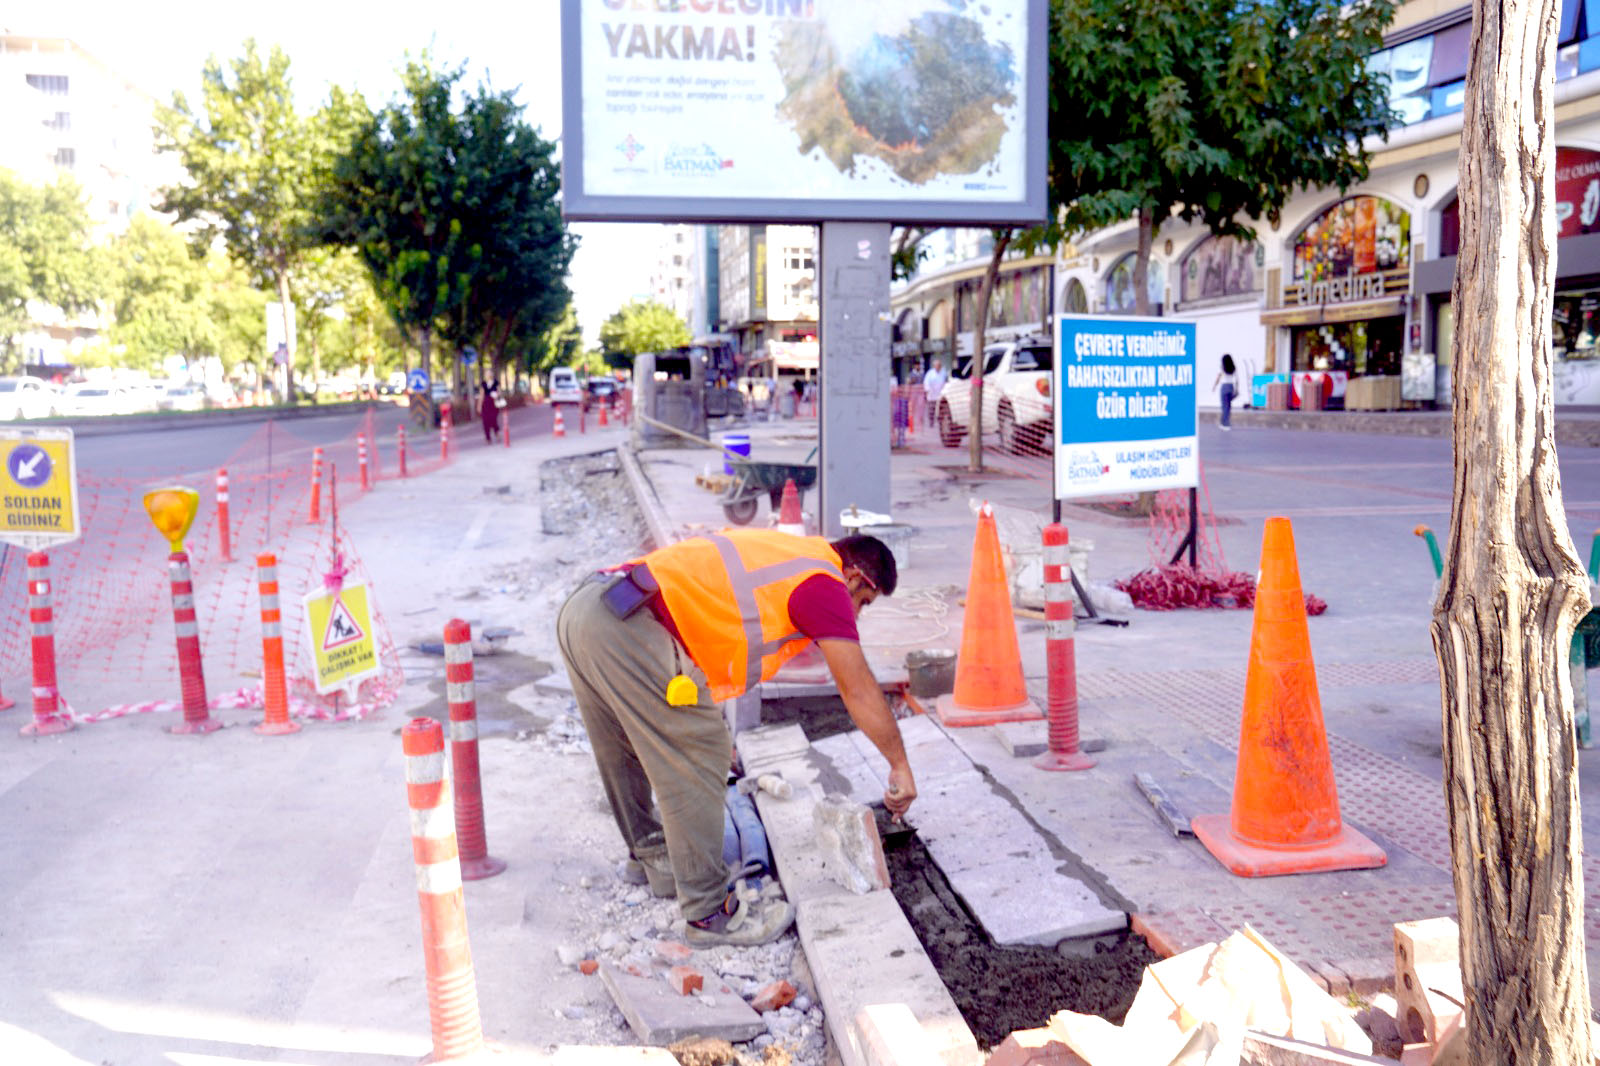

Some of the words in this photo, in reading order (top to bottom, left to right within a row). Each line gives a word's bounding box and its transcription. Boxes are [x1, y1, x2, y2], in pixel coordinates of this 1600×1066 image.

[602, 22, 755, 62] YAKMA!
[664, 156, 723, 171] BATMAN
[1297, 266, 1384, 305] elmedina
[1074, 333, 1125, 362] ÇEVREYE
[1126, 331, 1187, 357] VERDİĞİMİZ
[1067, 365, 1156, 388] RAHATSIZLIKTAN
[1157, 364, 1193, 387] DOLAYI
[1096, 391, 1126, 419] ÖZÜR
[1128, 390, 1168, 418] DİLERİZ
[1130, 462, 1179, 480] MÜDÜRLÜĞÜ
[4, 495, 62, 510] SOLDAN
[7, 511, 62, 527] GİDİNİZ
[328, 645, 358, 664] DİKKAT
[357, 650, 374, 664] VAR
